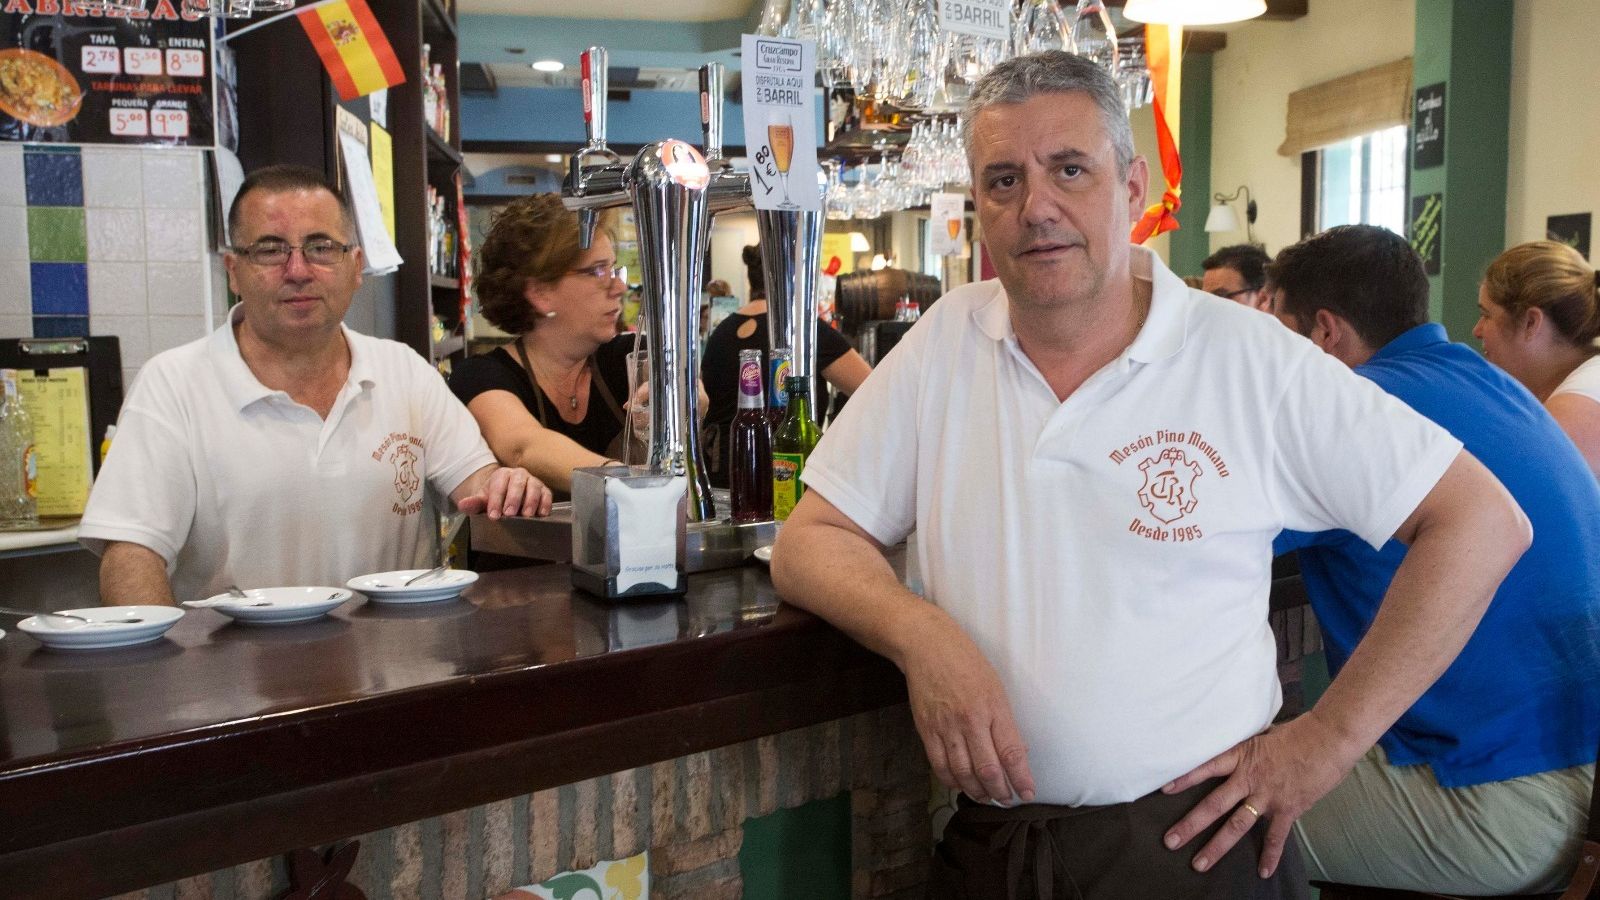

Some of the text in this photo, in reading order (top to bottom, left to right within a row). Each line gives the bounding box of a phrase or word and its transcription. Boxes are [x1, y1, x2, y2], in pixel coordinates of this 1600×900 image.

[954, 3, 1004, 28] BARRIL
[90, 34, 116, 45] TAPA
[168, 37, 206, 48] ENTERA
[155, 99, 188, 109] GRANDE
[764, 88, 804, 105] BARRIL
[1156, 429, 1185, 445] Pino
[1128, 518, 1203, 542] Desde 1985
